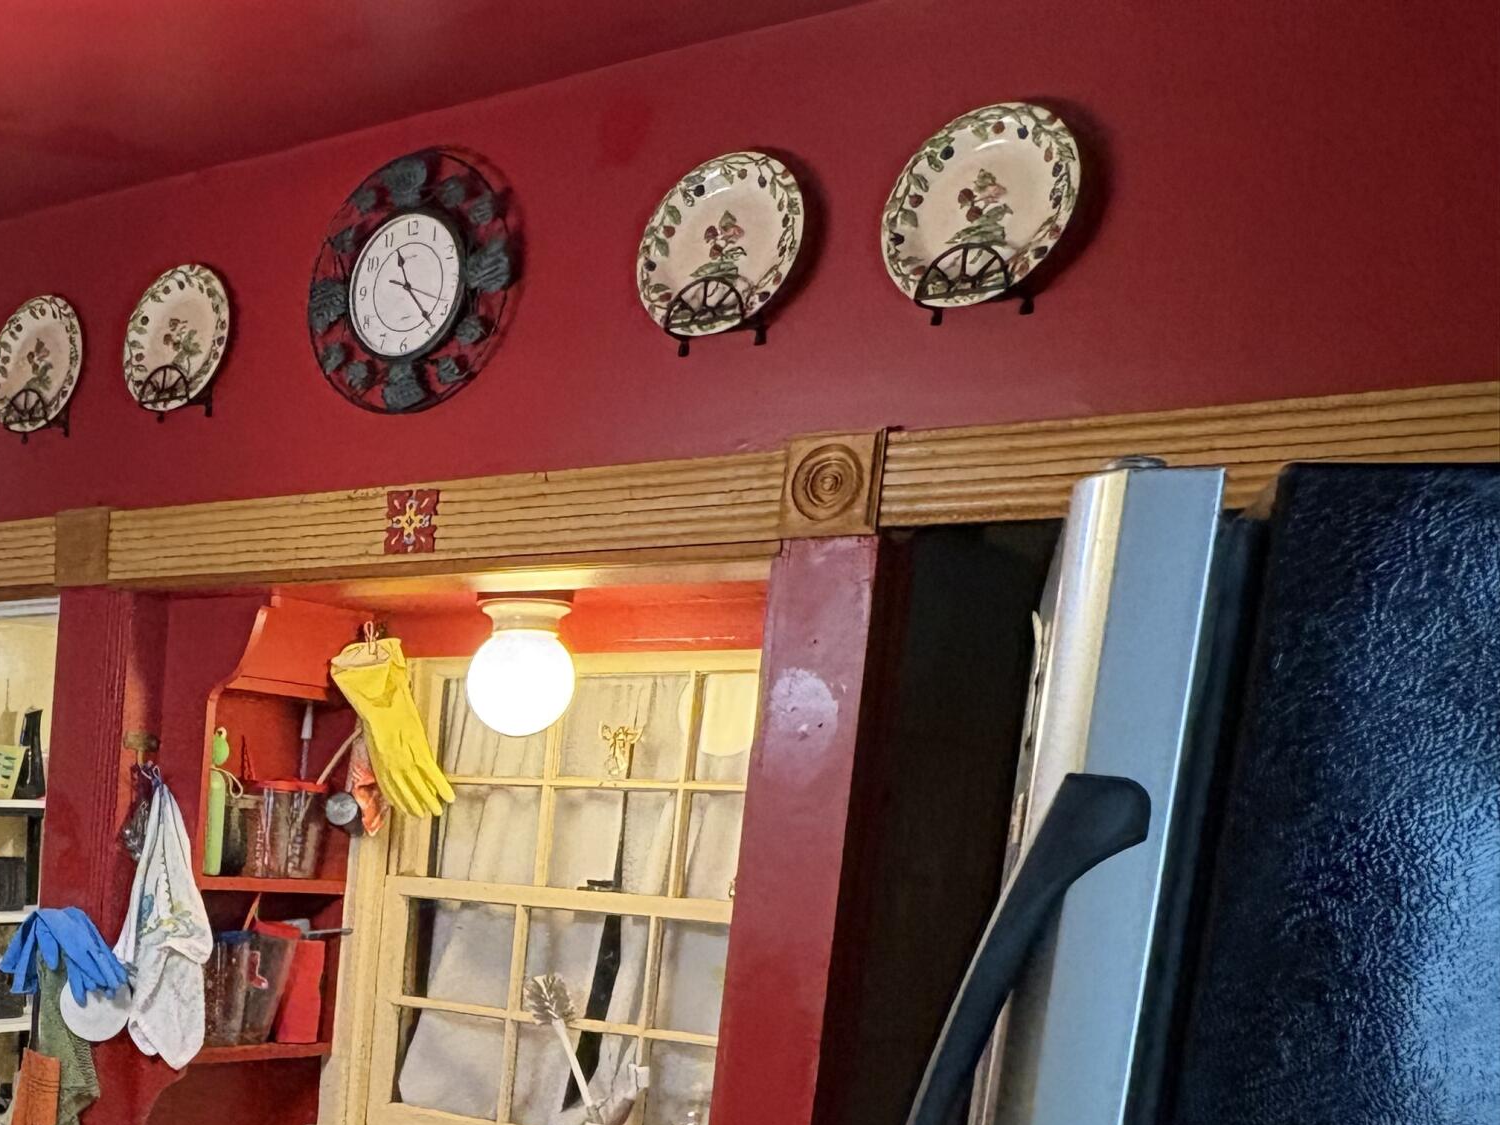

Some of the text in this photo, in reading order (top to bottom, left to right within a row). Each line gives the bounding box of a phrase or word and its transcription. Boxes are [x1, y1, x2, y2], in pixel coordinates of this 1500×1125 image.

[407, 220, 419, 236] 12
[384, 231, 395, 249] 11
[367, 256, 380, 273] 10
[359, 286, 368, 301] 9
[379, 332, 387, 351] 7
[399, 337, 408, 353] 6
